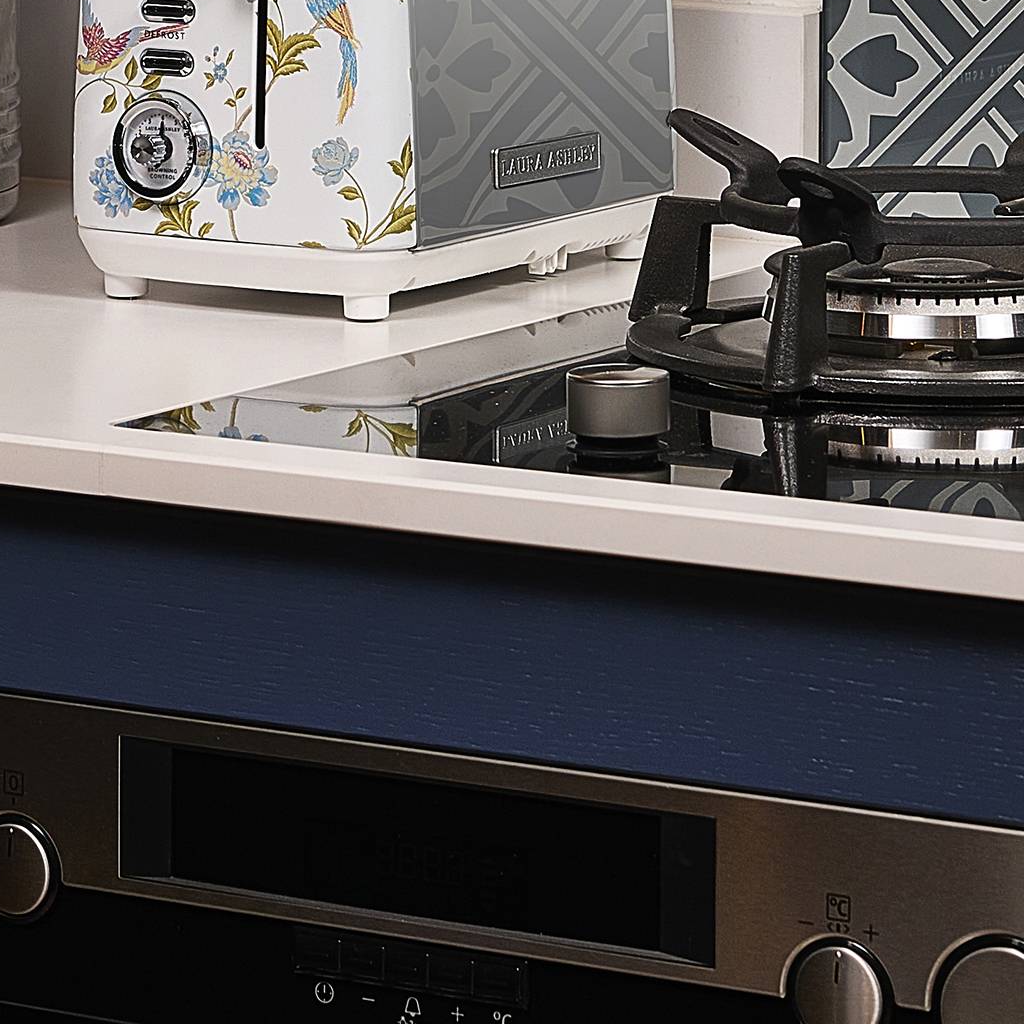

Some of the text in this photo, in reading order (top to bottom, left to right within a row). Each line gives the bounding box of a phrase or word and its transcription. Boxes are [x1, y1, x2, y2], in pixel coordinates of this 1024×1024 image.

[144, 29, 186, 40] DEFROST
[501, 144, 596, 176] LAURA ASHLEY
